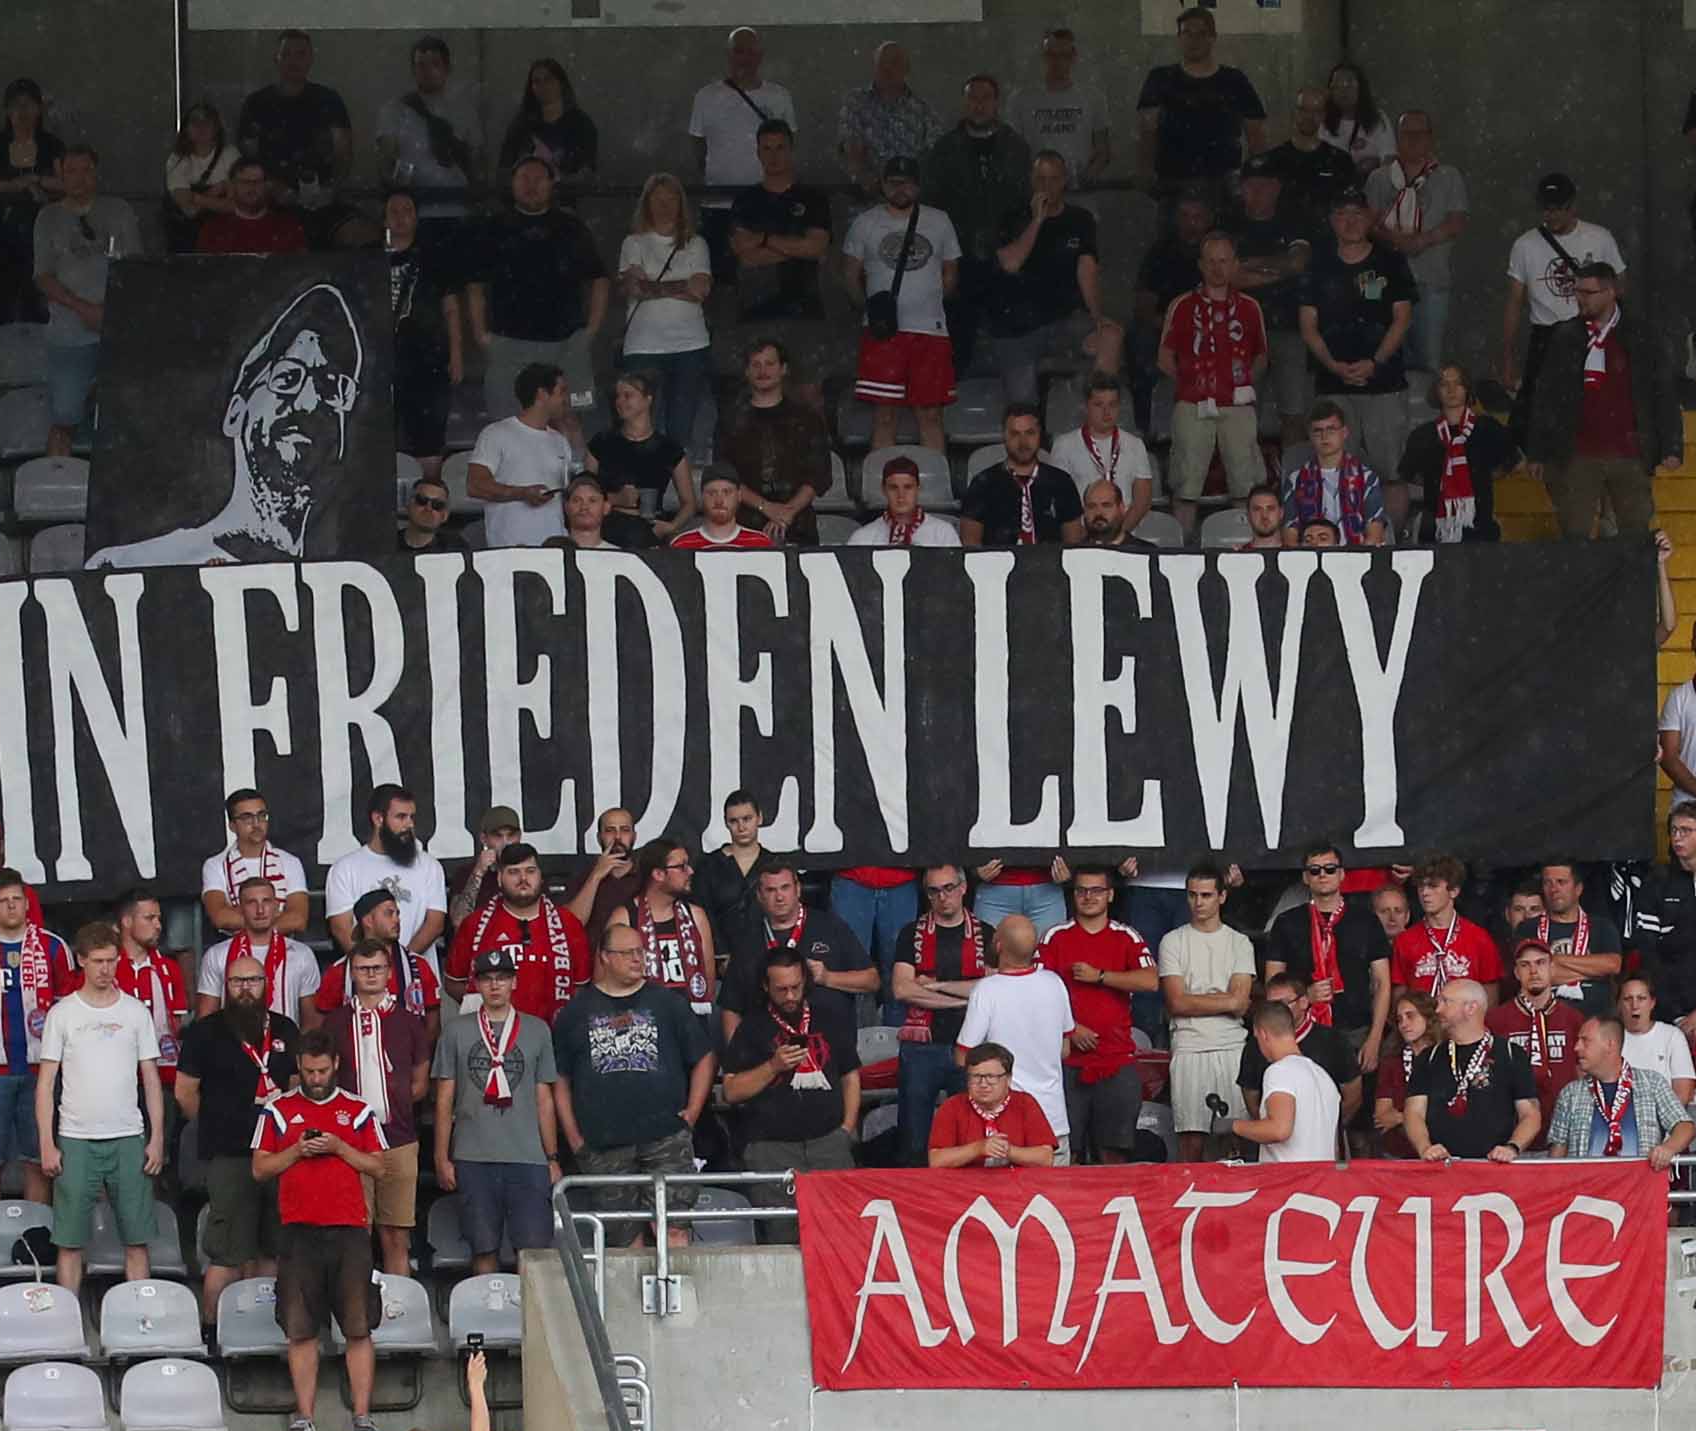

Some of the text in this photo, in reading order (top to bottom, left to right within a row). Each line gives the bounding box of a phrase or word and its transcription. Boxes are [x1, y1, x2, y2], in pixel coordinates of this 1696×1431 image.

[199, 549, 910, 866] FRIEDEN
[963, 549, 1433, 850] LEWY
[840, 1182, 1627, 1374] AMATEURE
